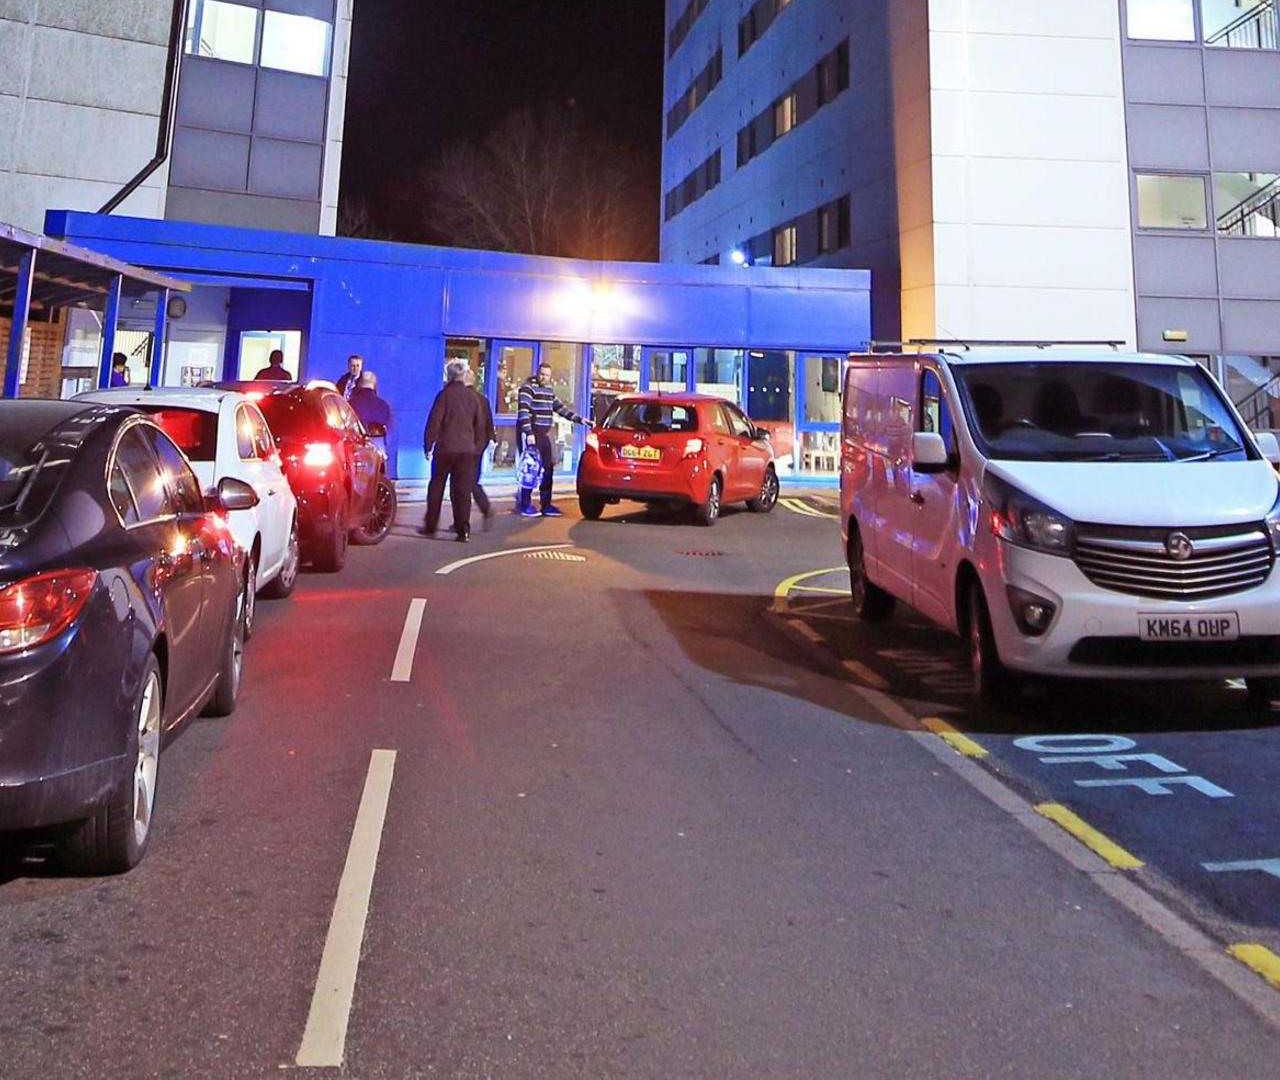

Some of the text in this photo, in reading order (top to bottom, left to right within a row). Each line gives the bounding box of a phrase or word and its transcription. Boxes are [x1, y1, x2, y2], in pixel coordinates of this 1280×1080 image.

[1147, 619, 1230, 637] KM64 OUP
[1013, 734, 1236, 798] OFF
